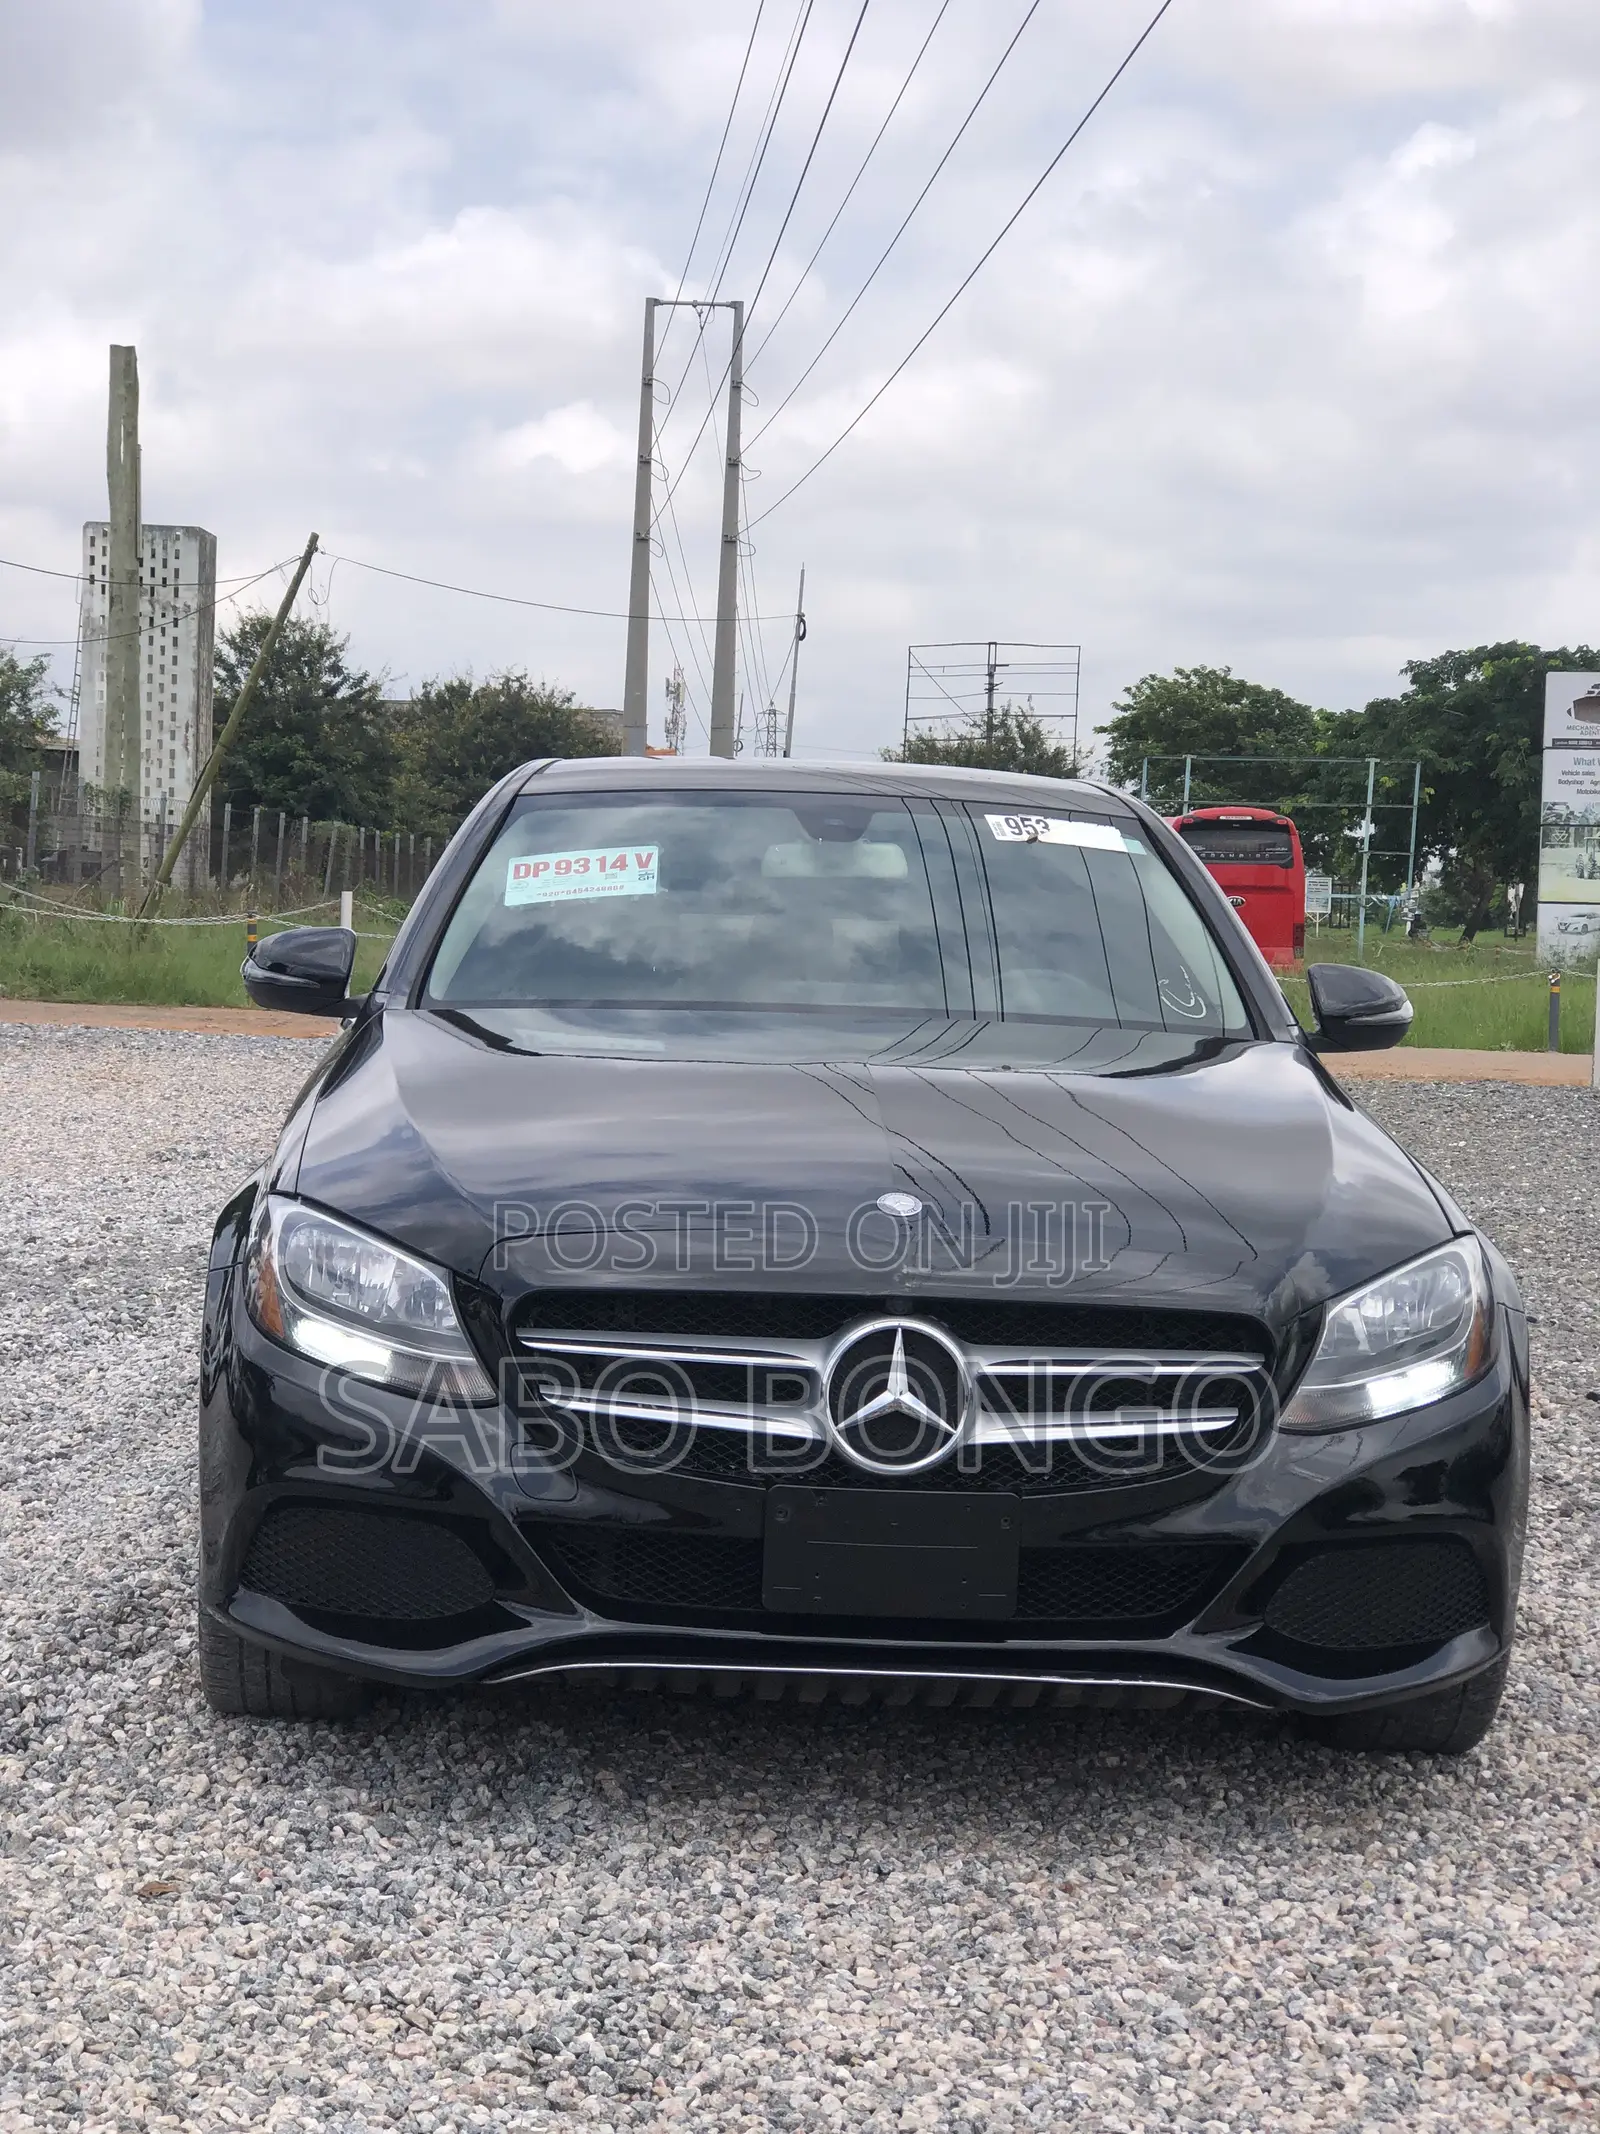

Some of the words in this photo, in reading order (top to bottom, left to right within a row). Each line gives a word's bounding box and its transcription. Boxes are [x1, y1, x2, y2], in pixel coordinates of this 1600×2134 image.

[1573, 757, 1596, 766] What
[1004, 816, 1050, 836] 953
[513, 861, 551, 880] DP
[554, 853, 629, 876] 9314
[634, 852, 654, 869] V
